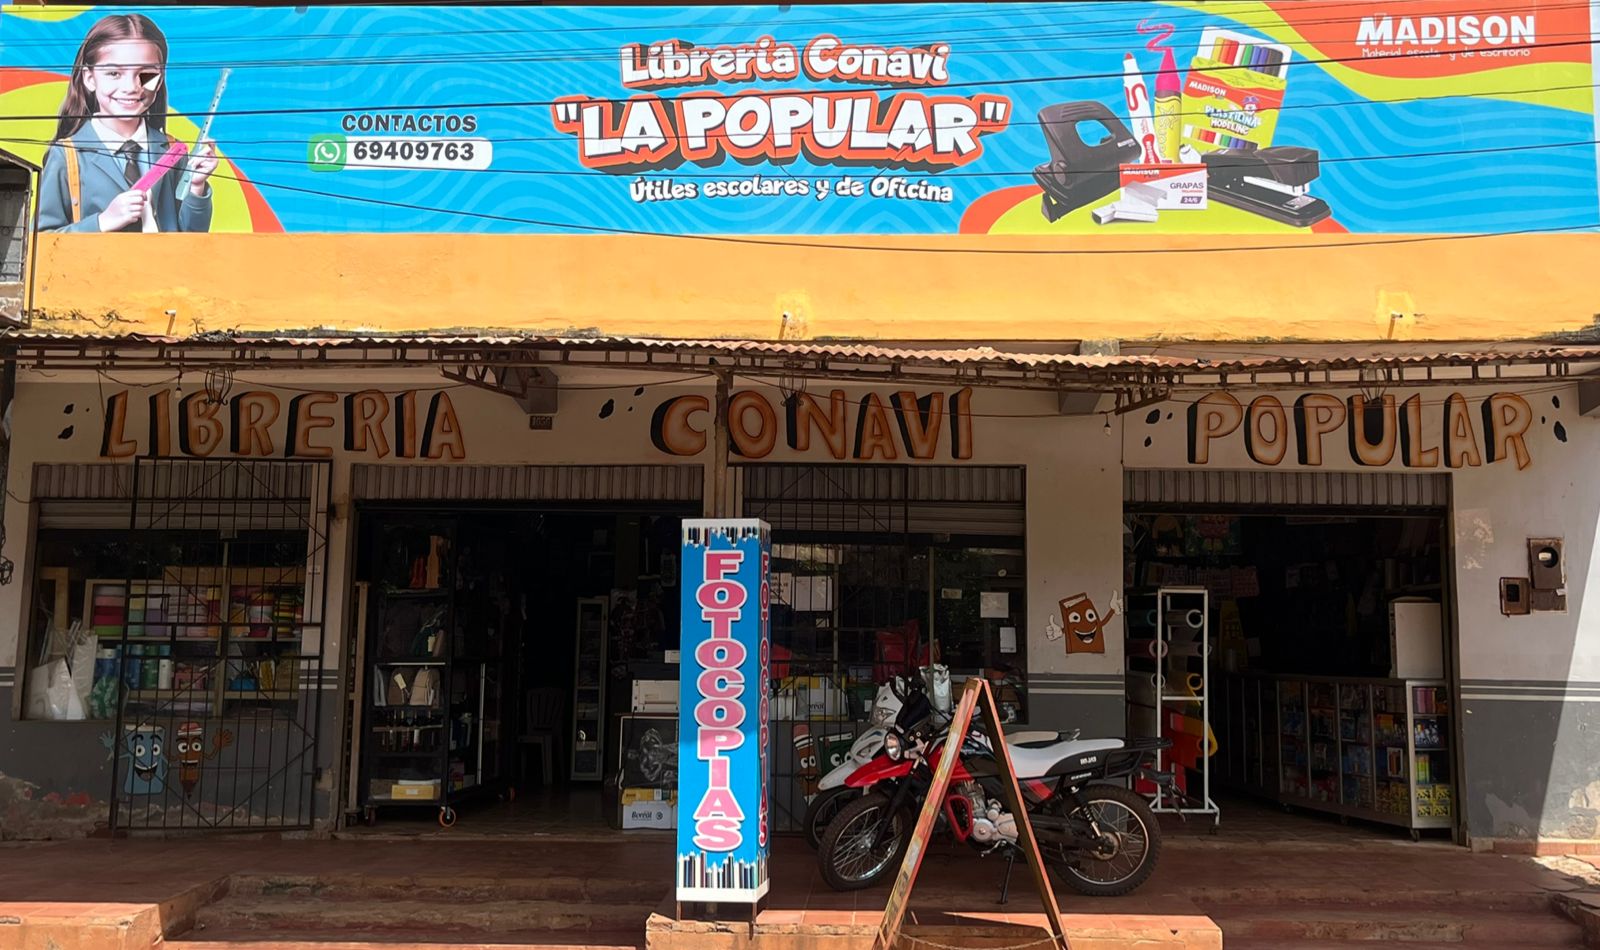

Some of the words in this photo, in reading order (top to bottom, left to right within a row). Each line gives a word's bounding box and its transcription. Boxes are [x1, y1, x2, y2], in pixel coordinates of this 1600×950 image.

[1355, 15, 1536, 46] MADISON
[620, 37, 798, 84] Libreria
[807, 37, 950, 82] Conavi
[1189, 80, 1227, 96] MADISON
[341, 113, 478, 132] CONTACTOS
[352, 140, 476, 163] 69409763
[629, 176, 699, 203] Útiles
[702, 174, 811, 199] escolares
[815, 179, 831, 200] y
[836, 176, 865, 196] de
[100, 388, 466, 460] LIBRERIA
[651, 386, 974, 461] CONAVI
[1187, 391, 1533, 471] POPULAR
[693, 550, 748, 851] FOTOCOPIAS
